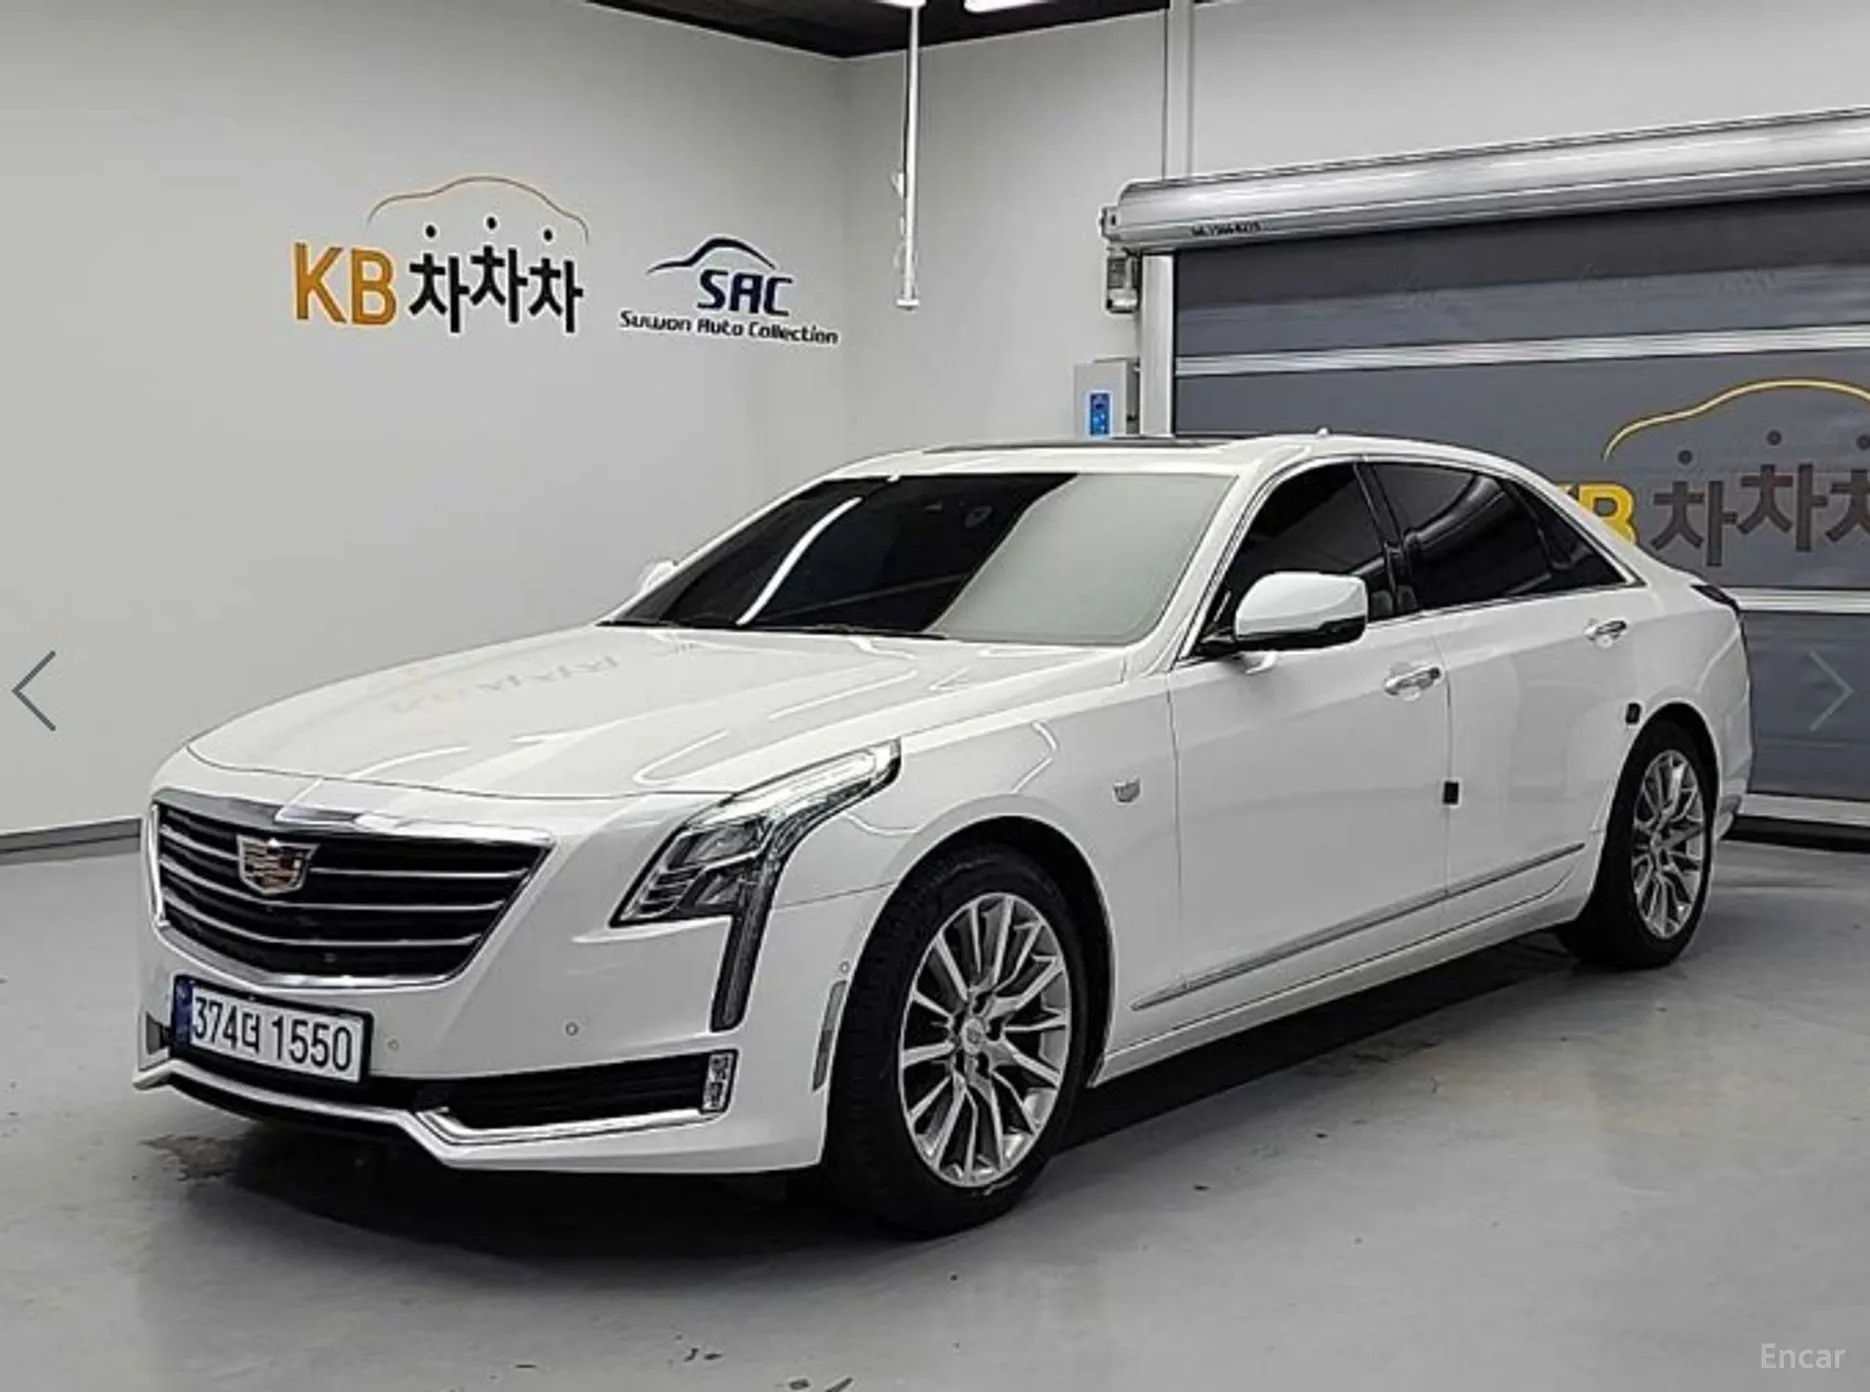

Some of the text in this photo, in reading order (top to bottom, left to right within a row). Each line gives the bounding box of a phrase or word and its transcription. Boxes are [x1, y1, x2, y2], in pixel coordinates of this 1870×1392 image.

[294, 242, 584, 333] KB 차차차
[697, 269, 793, 317] SAC
[619, 310, 839, 345] Suwon Auto Collection
[1556, 482, 1637, 545] B
[193, 997, 353, 1071] 374더 1550
